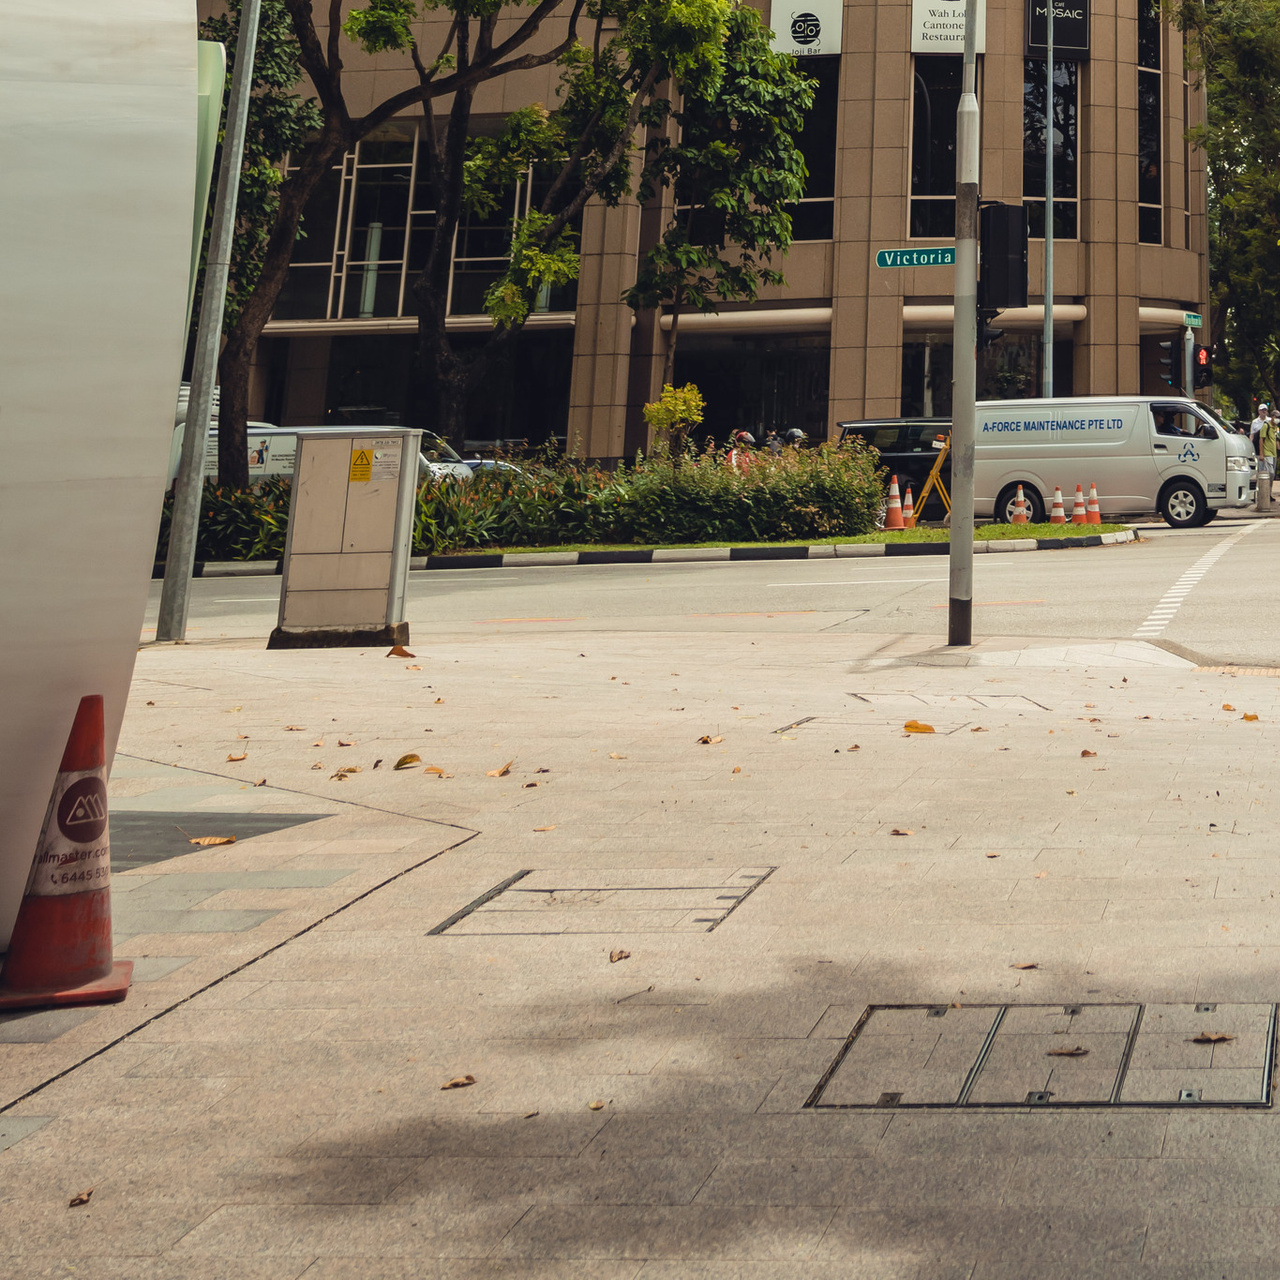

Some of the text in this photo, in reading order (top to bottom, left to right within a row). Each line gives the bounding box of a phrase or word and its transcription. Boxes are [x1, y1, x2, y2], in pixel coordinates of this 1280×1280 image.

[928, 9, 950, 18] Wah
[922, 20, 966, 30] Cantone
[921, 32, 966, 41] Restaura
[807, 47, 822, 55] Bar
[884, 250, 952, 266] Victoria
[982, 418, 1123, 433] A-FORCE MAINTENANCE PTE LTD
[61, 868, 93, 884] 6445
